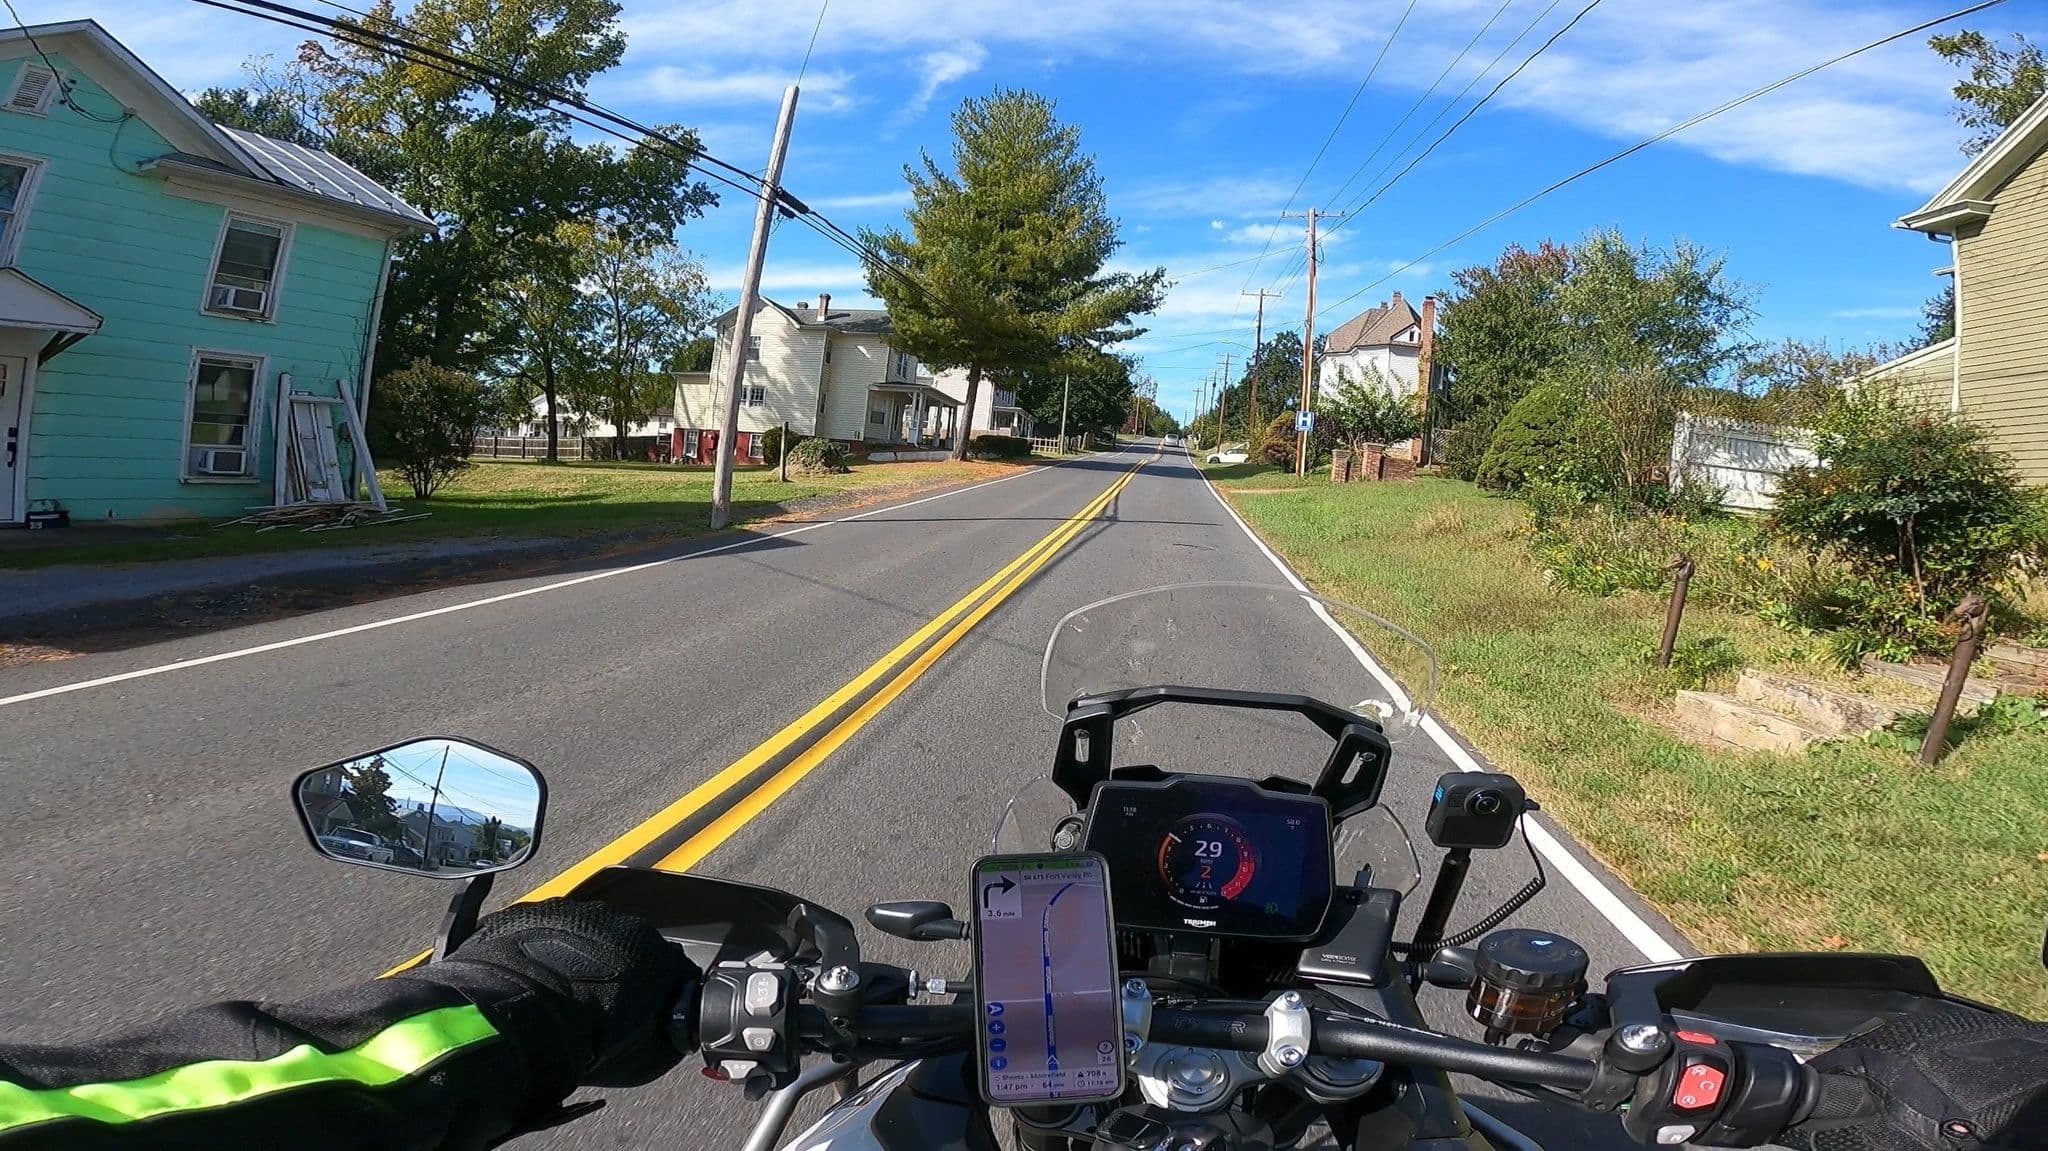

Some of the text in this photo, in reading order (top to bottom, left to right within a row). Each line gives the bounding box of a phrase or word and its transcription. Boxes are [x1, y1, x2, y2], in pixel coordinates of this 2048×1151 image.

[1194, 840, 1223, 858] 29
[1201, 865, 1212, 879] 2
[1183, 918, 1217, 928] TRIUMPH
